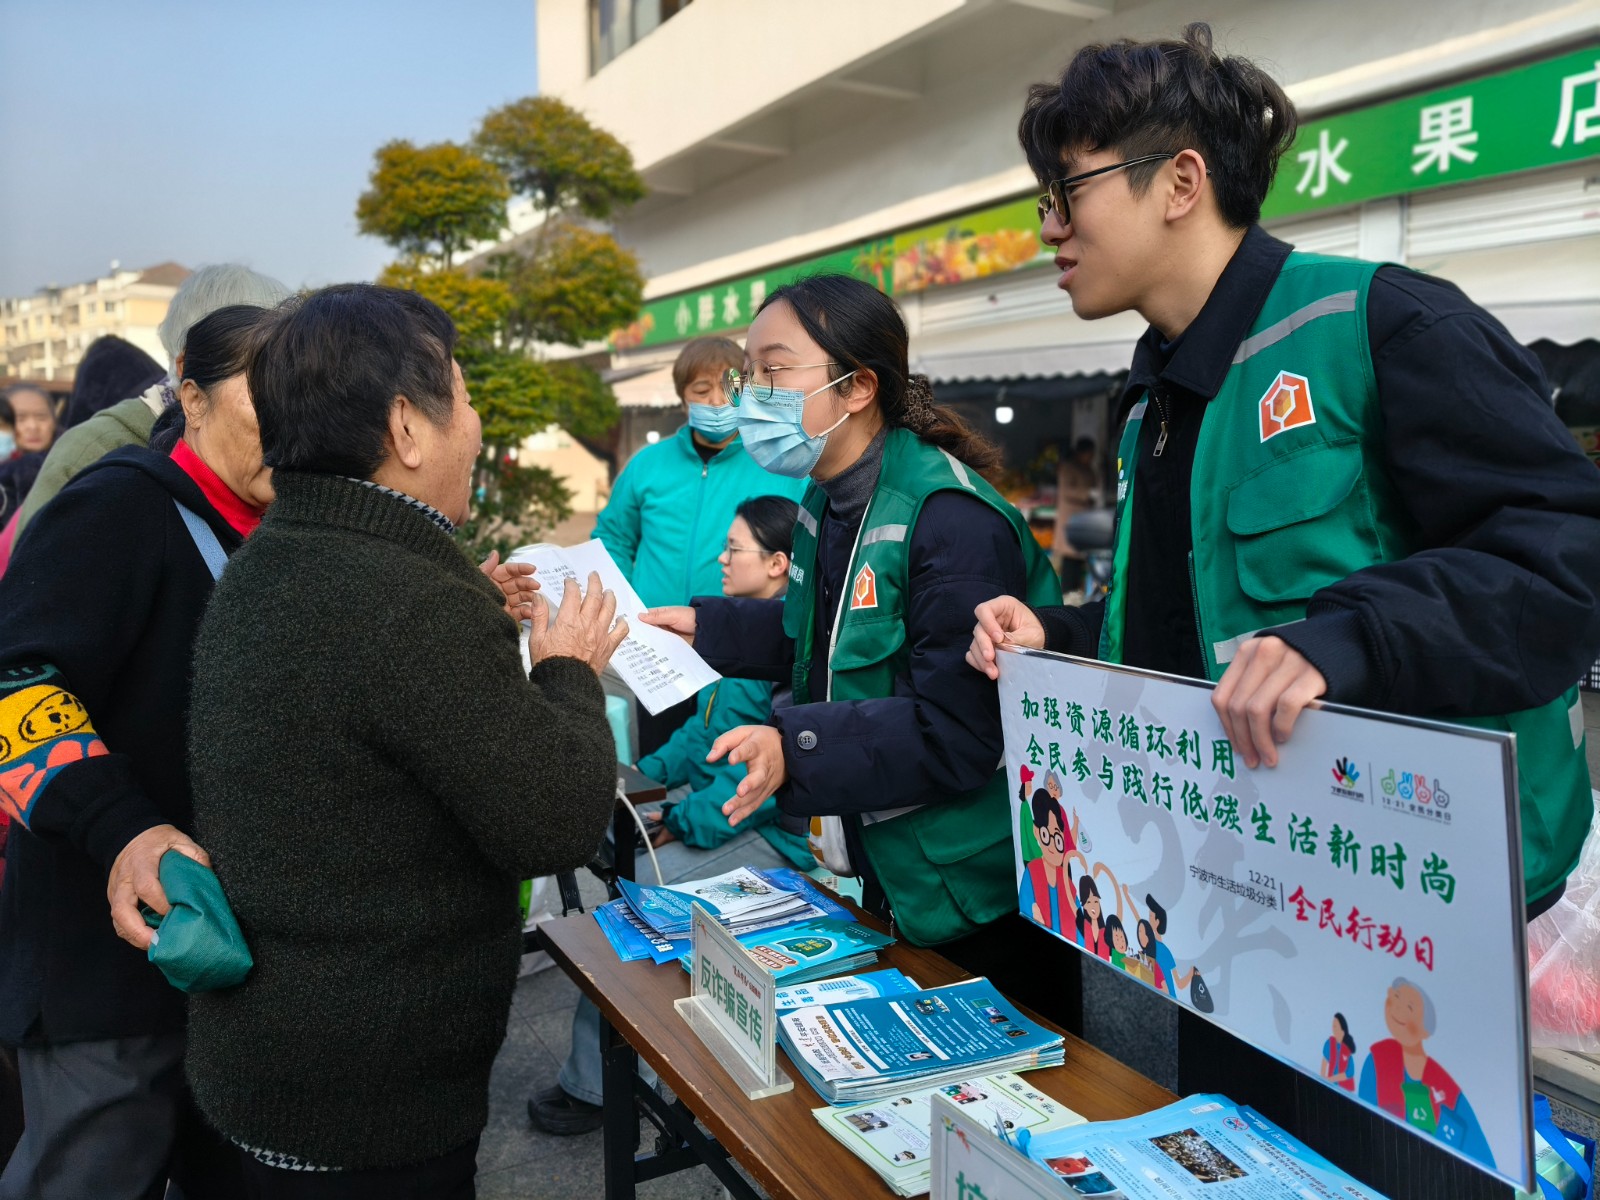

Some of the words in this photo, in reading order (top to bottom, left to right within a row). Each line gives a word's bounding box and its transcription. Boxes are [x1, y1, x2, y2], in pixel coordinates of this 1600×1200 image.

[1020, 690, 1236, 781] 加强资源循环利用
[1024, 733, 1457, 905] 全民参与践行低碳生活新时尚
[1188, 864, 1278, 911] 宁波市生活垃圾分类
[1288, 885, 1435, 973] 全民行动日
[701, 954, 763, 1051] 反诈骗宣传
